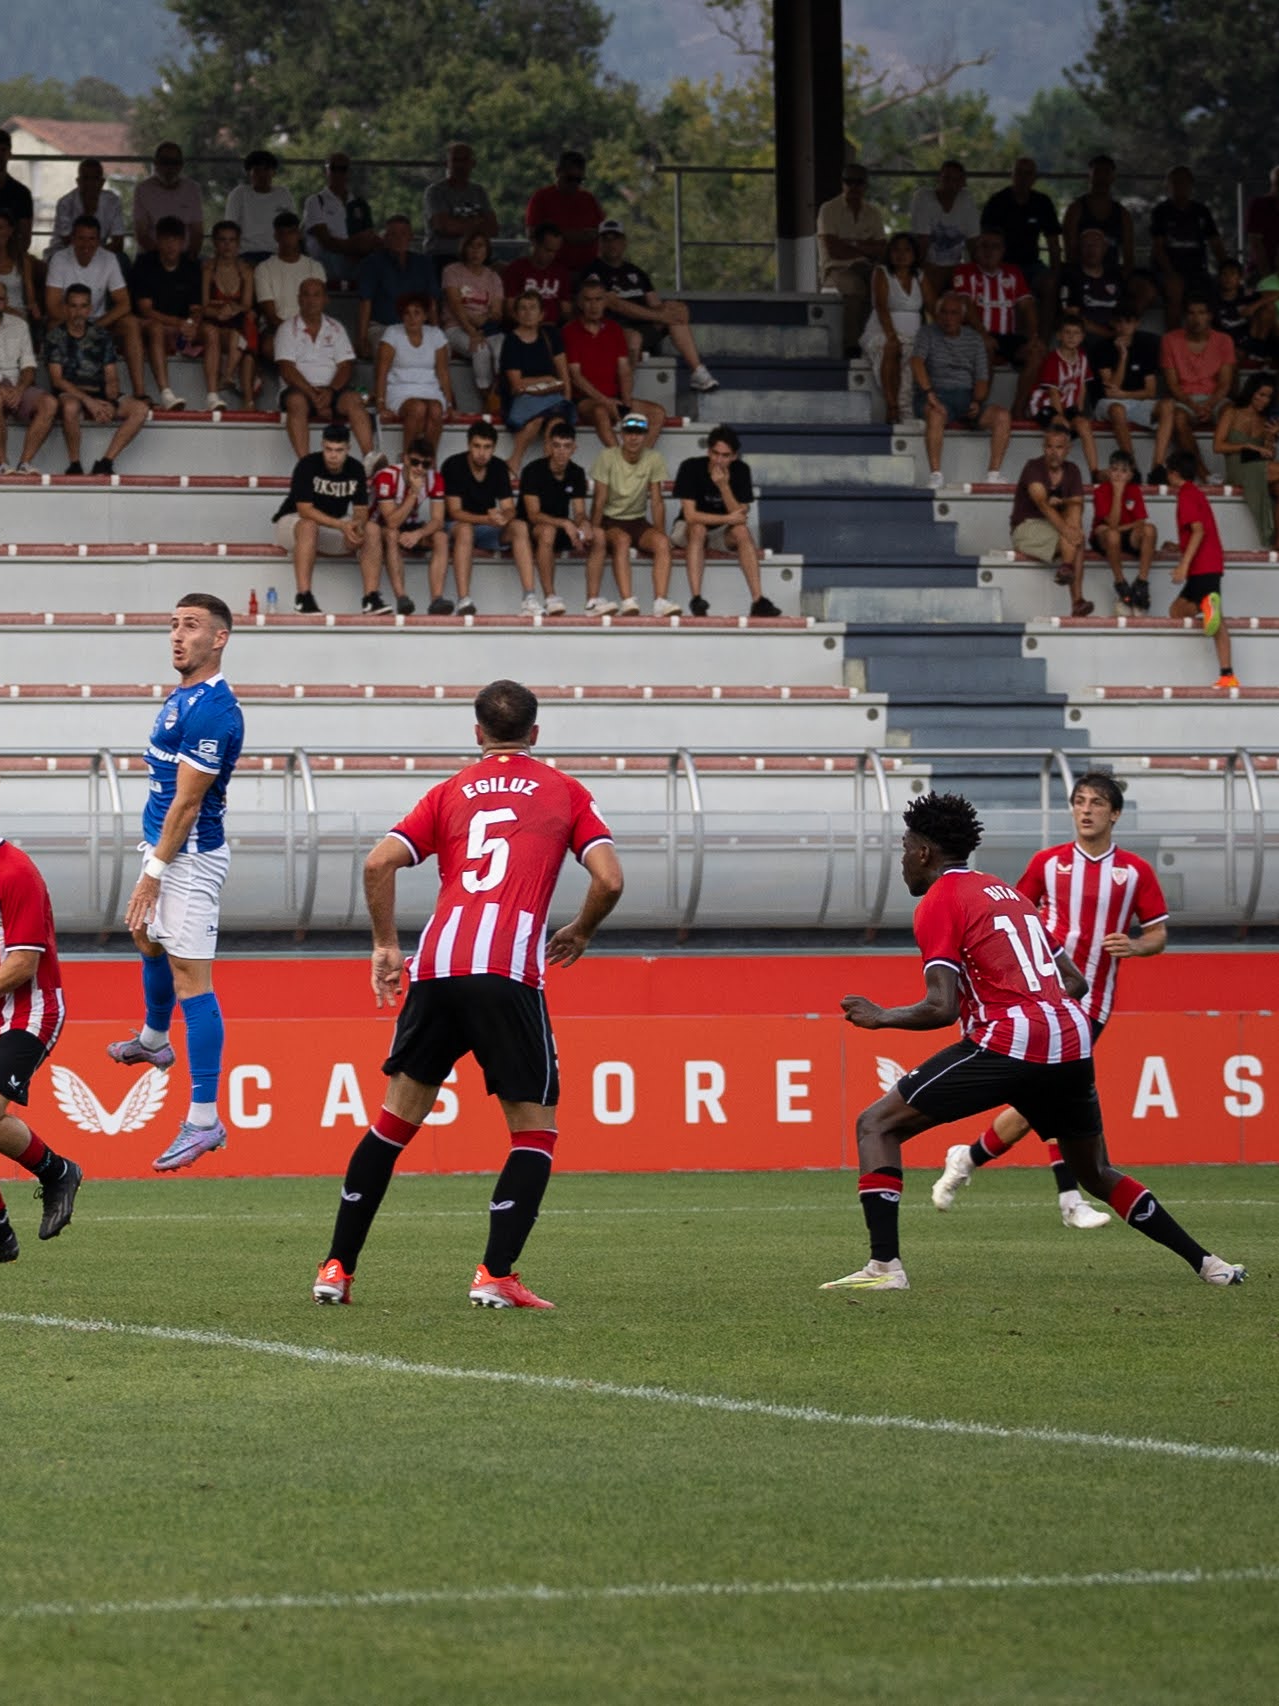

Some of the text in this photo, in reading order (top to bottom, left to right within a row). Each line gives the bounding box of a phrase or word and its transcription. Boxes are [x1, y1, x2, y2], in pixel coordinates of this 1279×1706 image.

[461, 776, 540, 800] EGILUZ
[461, 807, 518, 894] 5
[982, 885, 1021, 902] BITA
[993, 914, 1067, 992] 14
[228, 1059, 812, 1129] CASORE
